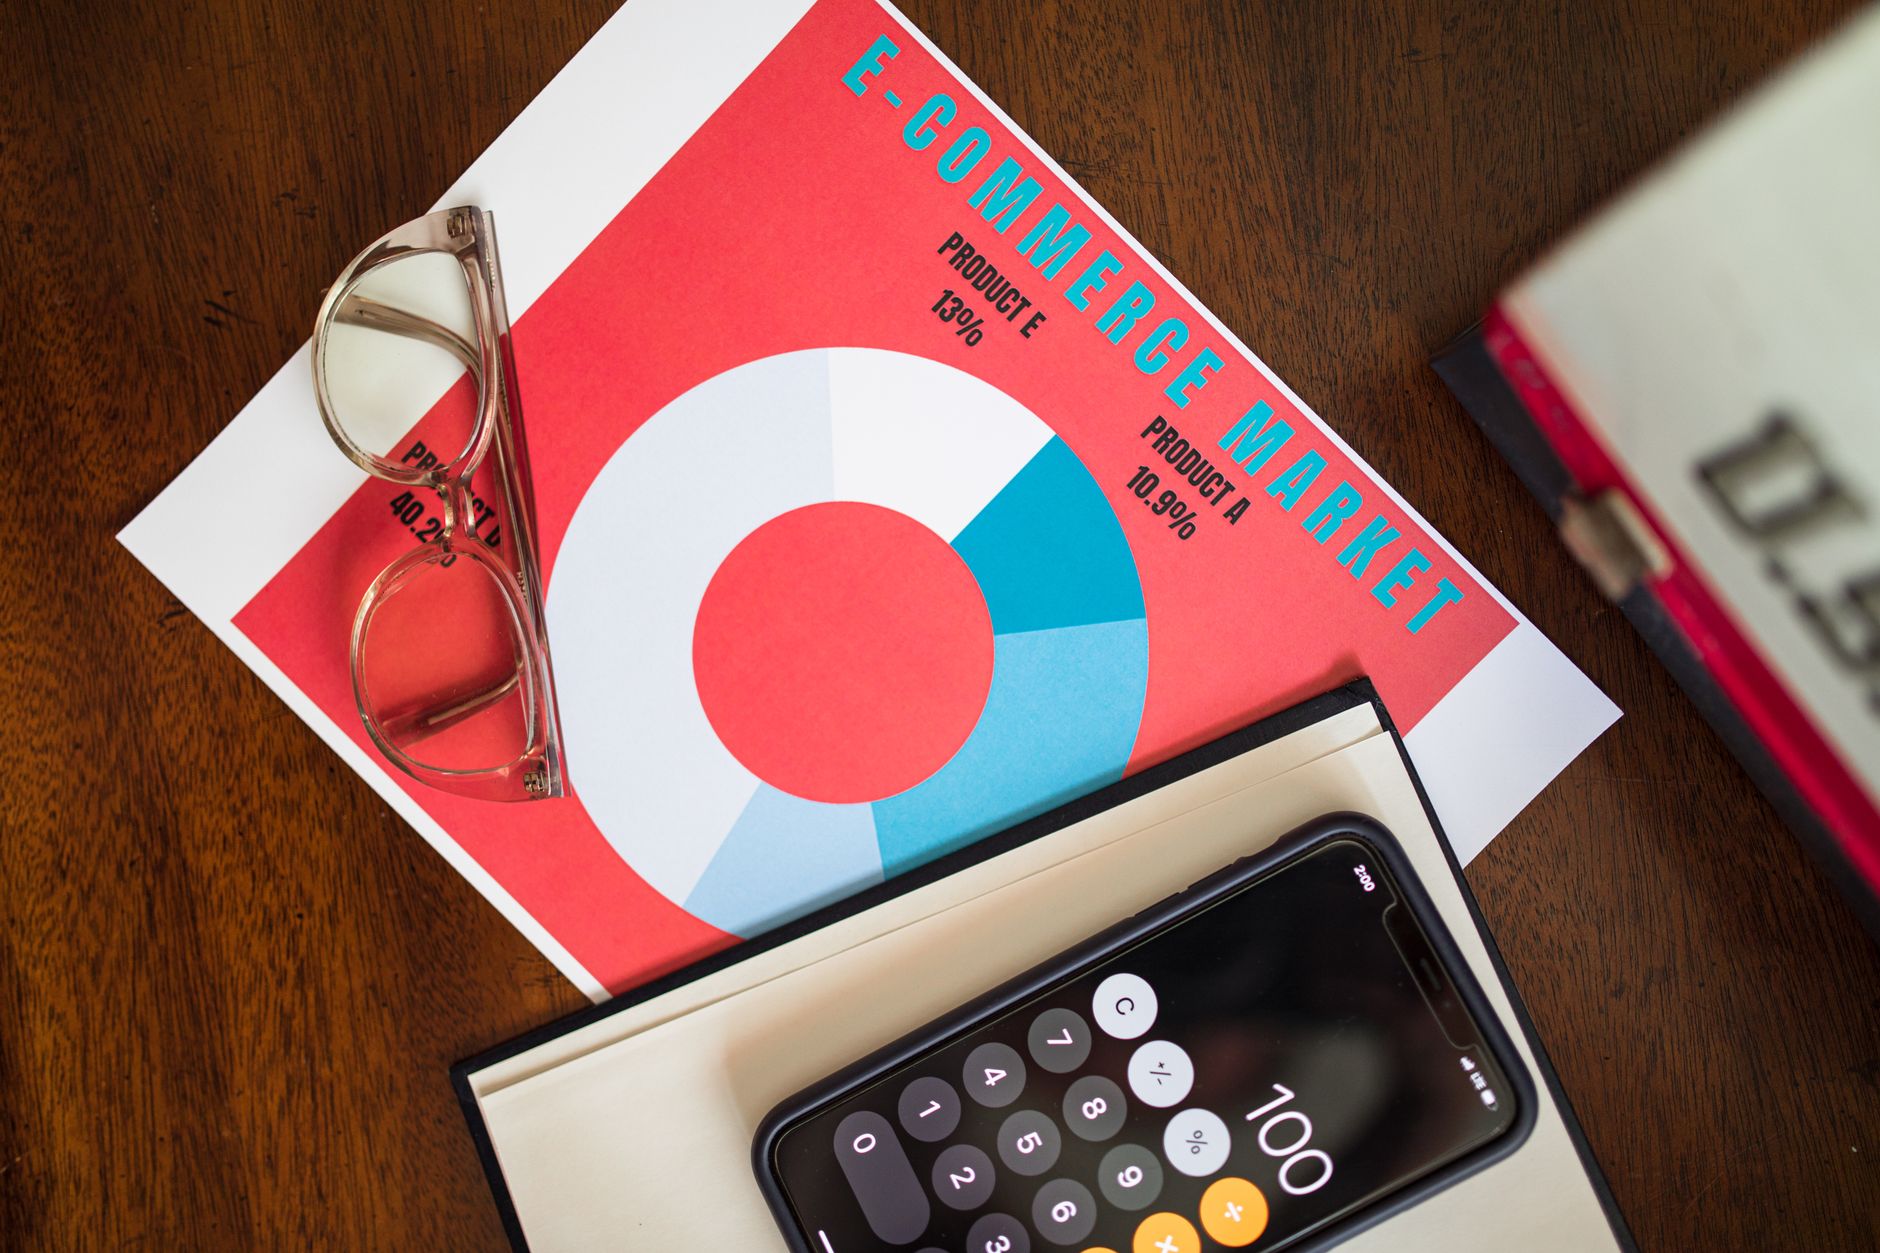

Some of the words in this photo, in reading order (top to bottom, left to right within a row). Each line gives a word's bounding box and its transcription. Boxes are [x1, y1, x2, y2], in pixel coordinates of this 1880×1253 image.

[937, 231, 1032, 322] PRODUCT
[1019, 311, 1047, 339] E
[931, 289, 984, 347] 13%
[841, 34, 1226, 410] E-COMMERCE
[1217, 399, 1465, 635] MARKET
[1140, 415, 1236, 507] PRODUCT
[1222, 497, 1251, 525] A
[1126, 465, 1197, 541] 10.9%
[1353, 864, 1376, 892] 2:00
[1116, 997, 1134, 1015] C
[1047, 1028, 1073, 1045] 7
[984, 1068, 1007, 1087] 4
[919, 1100, 941, 1118] 1
[1081, 1097, 1107, 1120] 8
[853, 1133, 876, 1154] 0
[1016, 1131, 1043, 1155] 5
[1185, 1130, 1208, 1155] %
[1246, 1083, 1334, 1195] 100
[949, 1166, 976, 1190] 2
[1117, 1165, 1143, 1188] 9
[1051, 1200, 1077, 1223] 6
[985, 1235, 1011, 1253] 3
